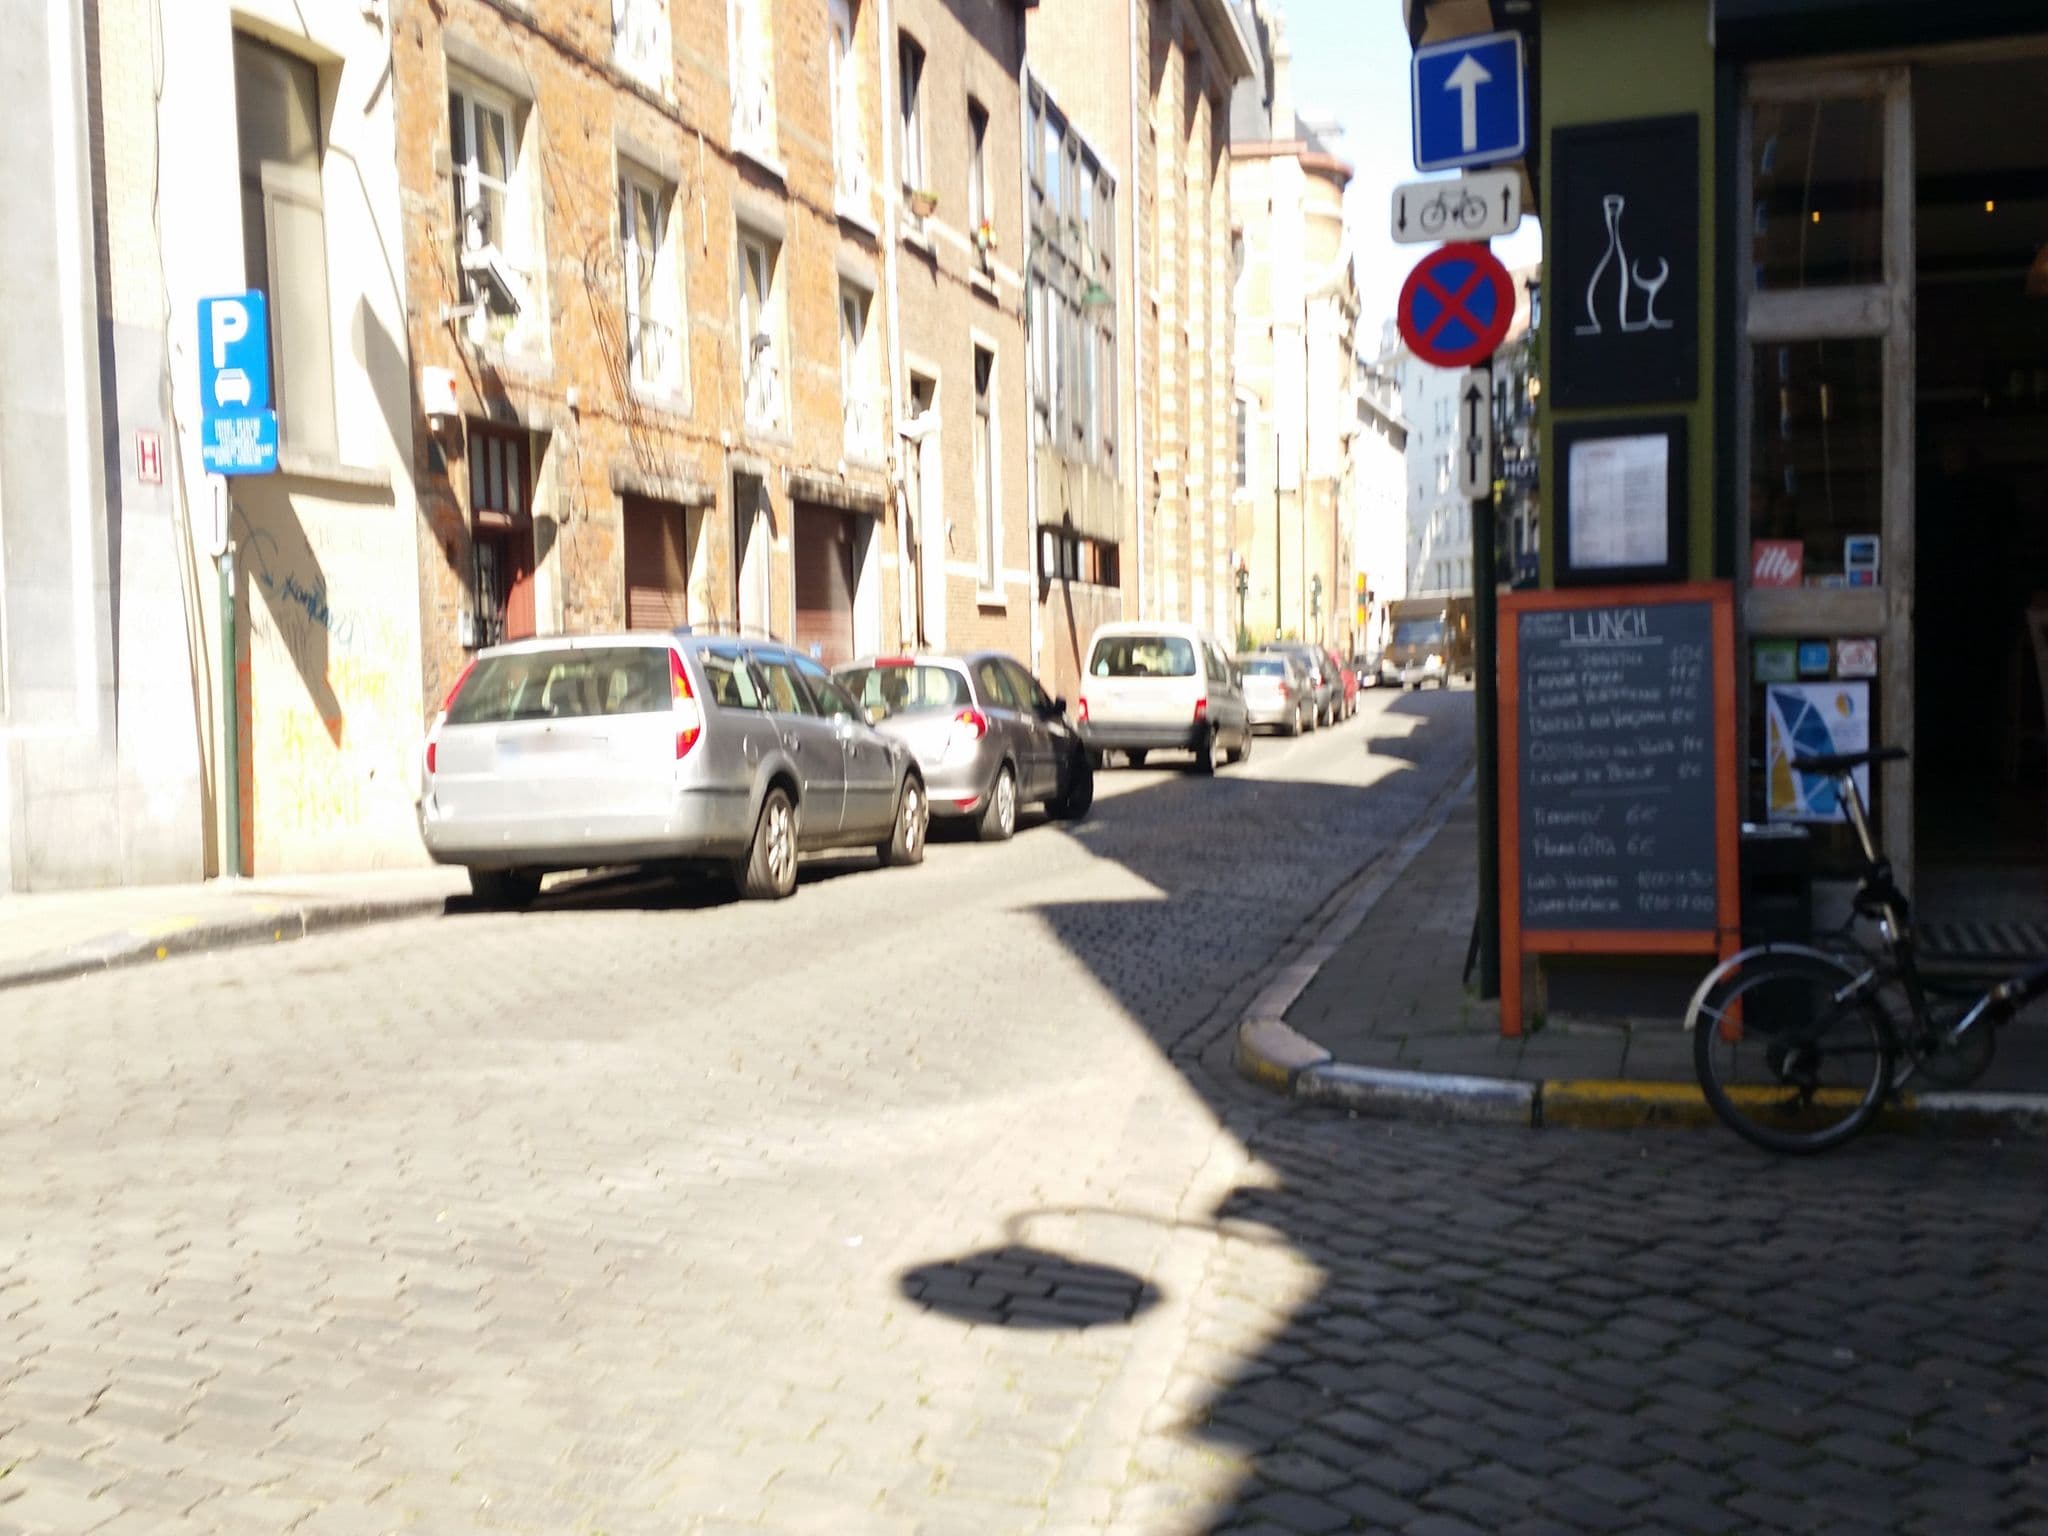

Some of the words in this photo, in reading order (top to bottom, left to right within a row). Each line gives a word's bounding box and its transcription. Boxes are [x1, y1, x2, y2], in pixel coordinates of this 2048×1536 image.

[211, 300, 248, 369] P
[140, 440, 157, 473] H
[1754, 546, 1799, 583] illy
[1568, 608, 1648, 642] LUNCH
